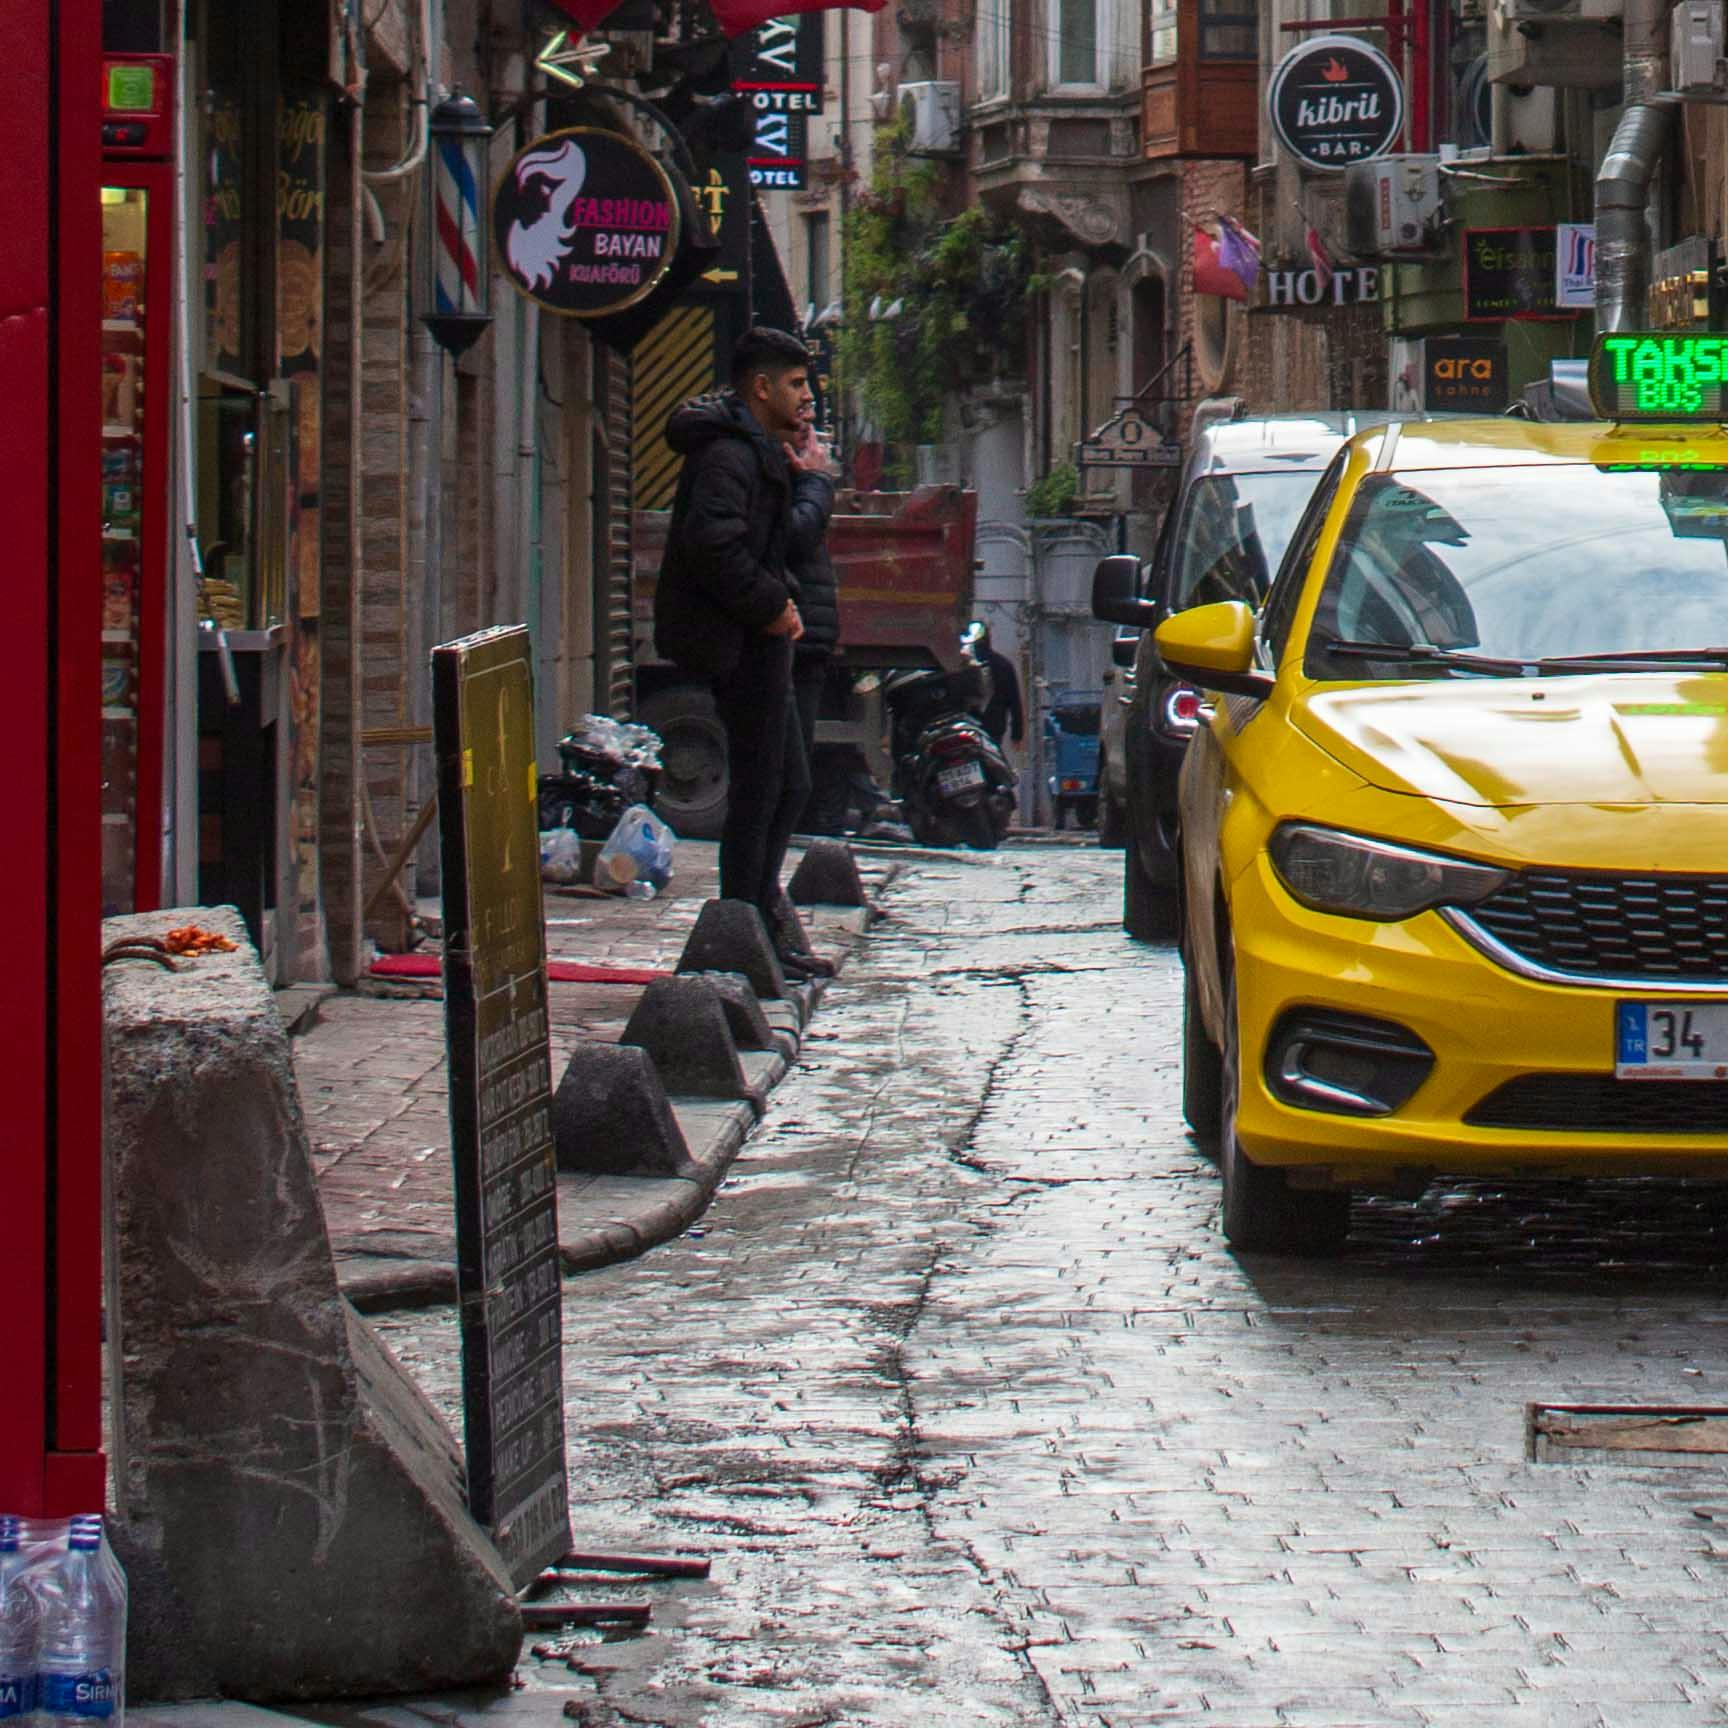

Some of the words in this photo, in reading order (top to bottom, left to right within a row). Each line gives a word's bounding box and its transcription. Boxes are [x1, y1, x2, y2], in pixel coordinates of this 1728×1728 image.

[753, 93, 817, 109] OTEL
[1319, 141, 1362, 156] BAR
[750, 171, 799, 184] OTEL
[573, 198, 670, 226] FASHION
[594, 234, 661, 257] BAYAN
[1268, 267, 1380, 306] HOTE
[1434, 357, 1492, 380] ara
[1652, 1010, 1704, 1058] 34
